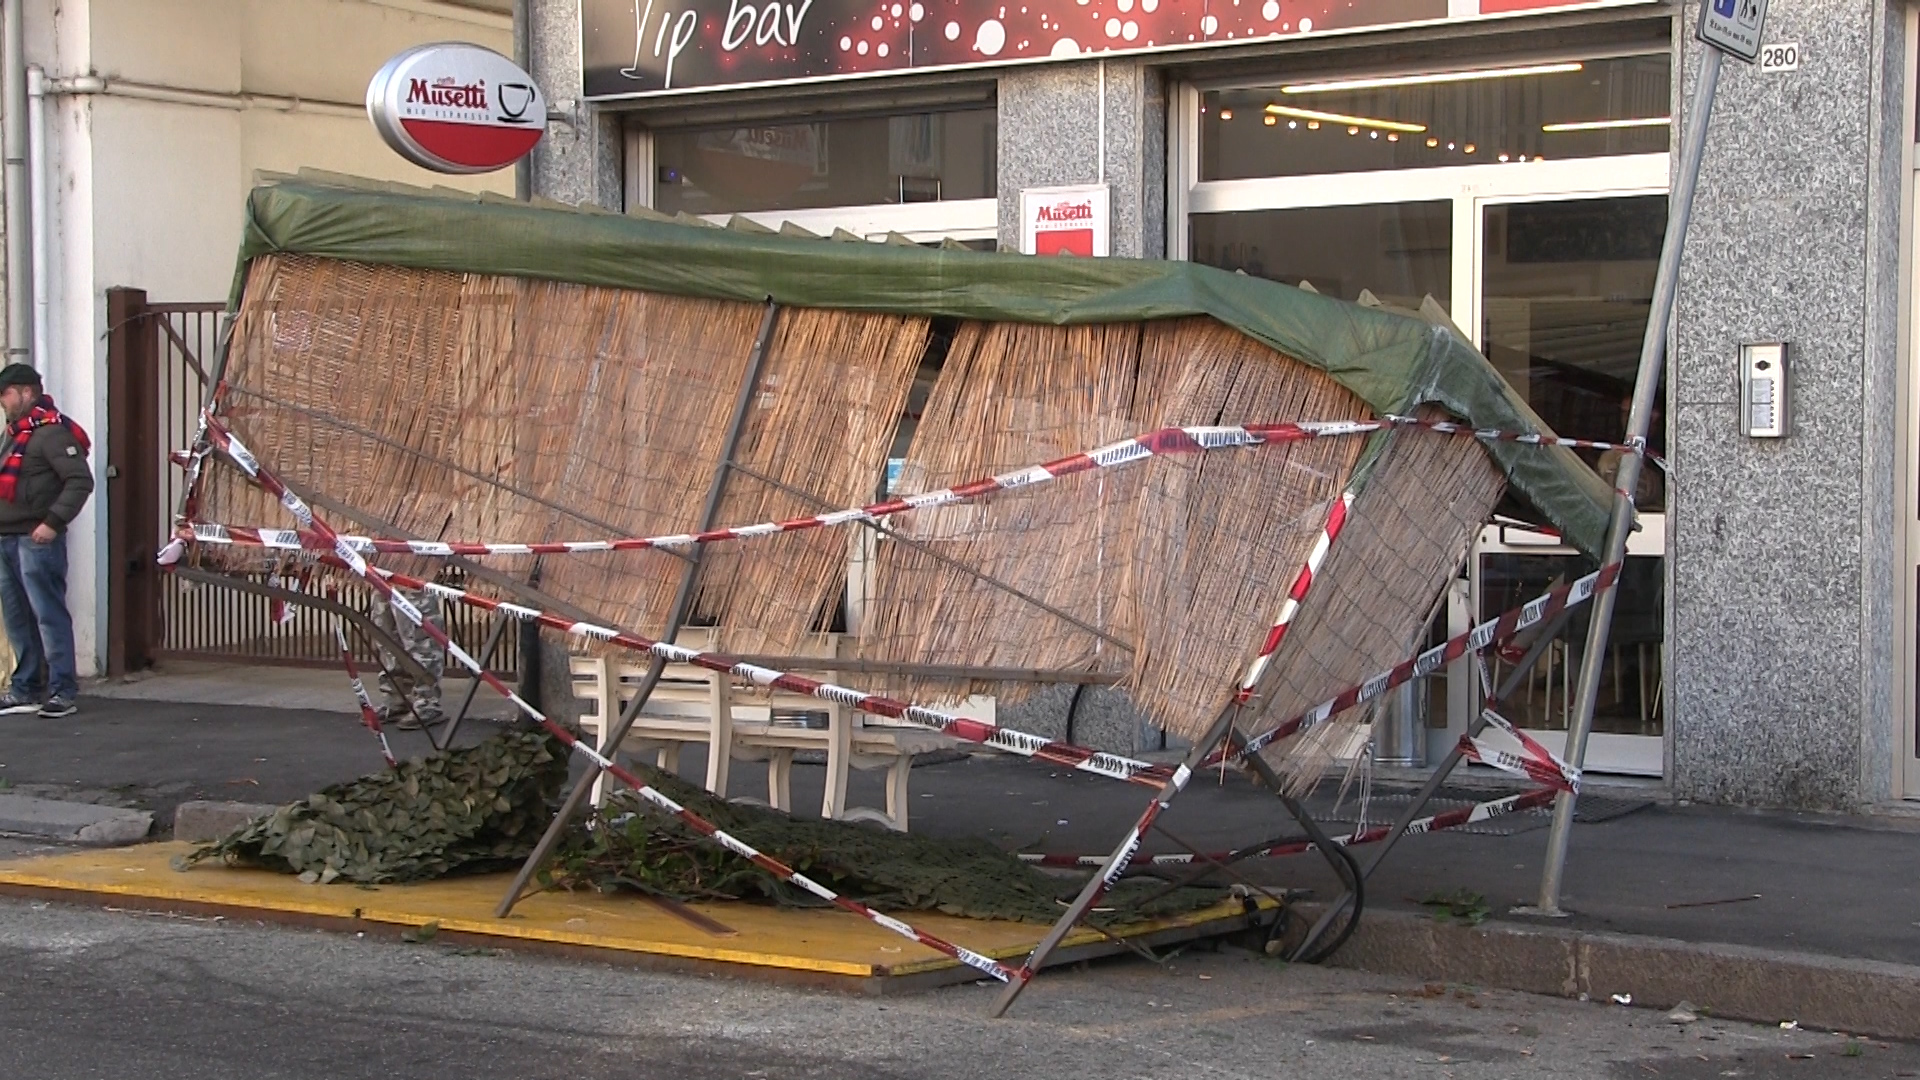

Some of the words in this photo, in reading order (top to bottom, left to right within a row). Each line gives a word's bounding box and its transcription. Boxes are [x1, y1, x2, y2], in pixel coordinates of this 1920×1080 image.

[721, 0, 814, 51] bar
[1763, 47, 1796, 68] 280
[406, 78, 488, 109] Musetti
[1036, 199, 1094, 222] Musetti
